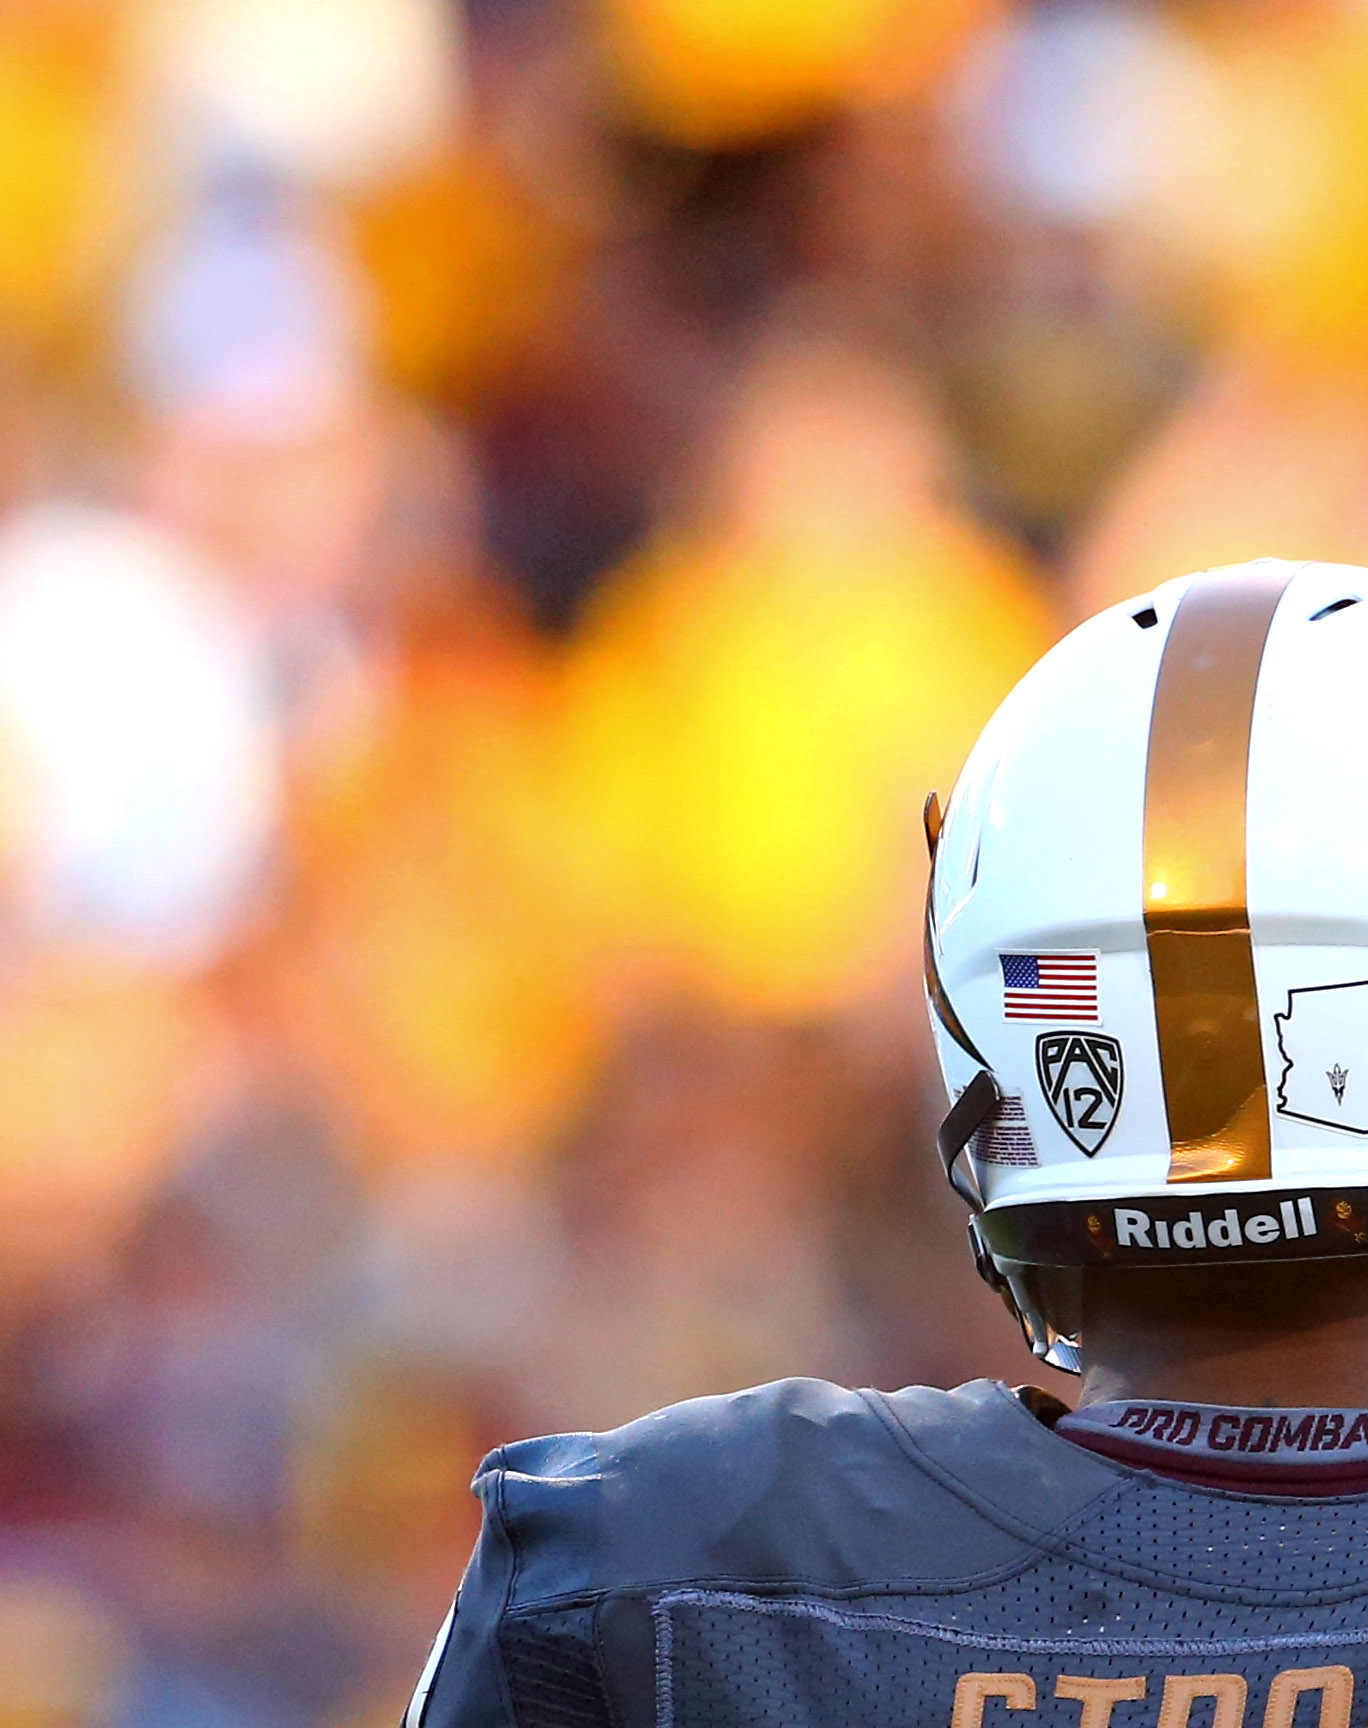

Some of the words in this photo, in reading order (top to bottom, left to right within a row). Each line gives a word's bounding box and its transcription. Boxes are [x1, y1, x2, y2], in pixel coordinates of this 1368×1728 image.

[1041, 1038, 1119, 1109] PAC
[1063, 1086, 1107, 1130] 12
[1114, 1197, 1318, 1249] Riddell
[1108, 1407, 1199, 1446] PRO
